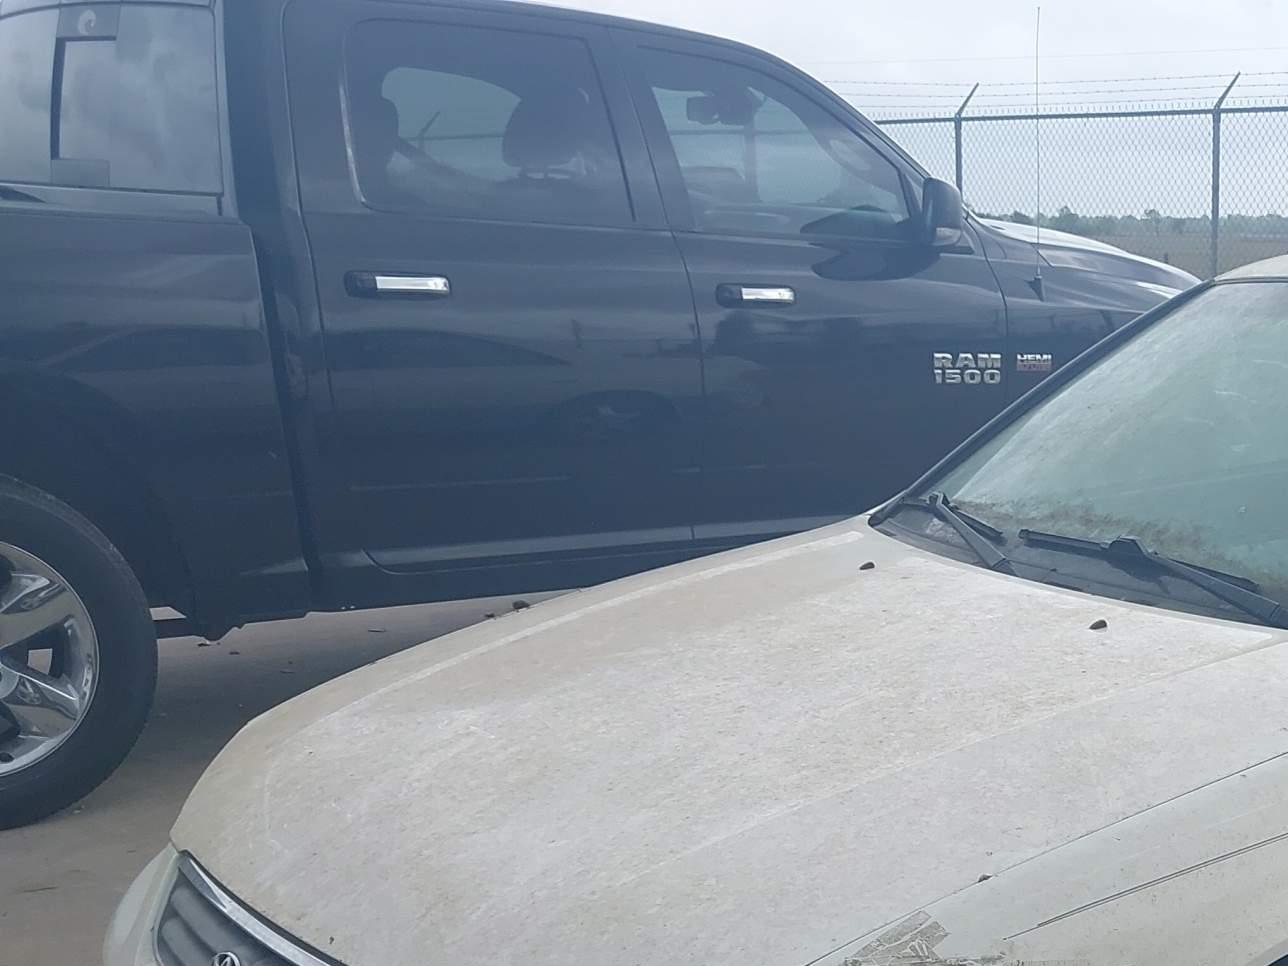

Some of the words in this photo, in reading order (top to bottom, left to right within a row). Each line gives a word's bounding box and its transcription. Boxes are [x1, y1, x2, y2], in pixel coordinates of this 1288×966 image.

[933, 352, 1002, 368] RAM
[1016, 353, 1053, 362] HEMI
[934, 369, 1001, 384] 1500
